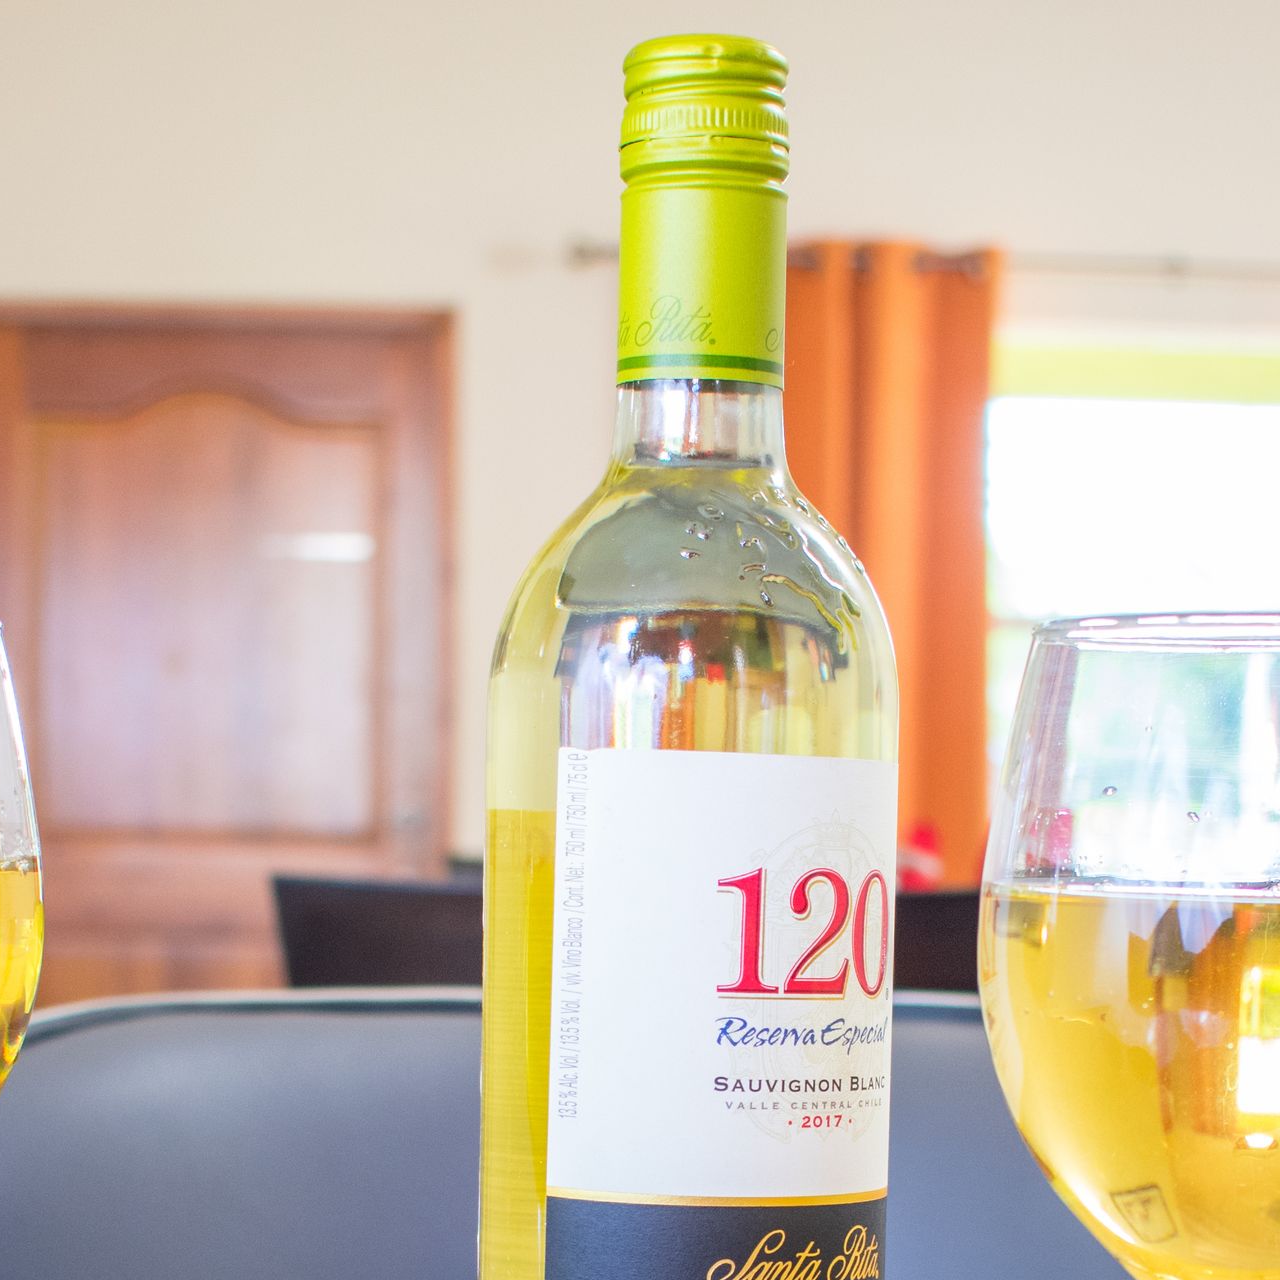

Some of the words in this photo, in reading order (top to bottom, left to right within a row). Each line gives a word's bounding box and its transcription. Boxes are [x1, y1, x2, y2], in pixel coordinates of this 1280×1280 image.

[567, 773, 587, 784] 75
[566, 791, 586, 802] ml
[566, 804, 586, 820] 750
[565, 827, 585, 839] ml
[565, 840, 585, 856] 750
[562, 917, 583, 947] Blanco
[716, 867, 889, 1000] 120
[561, 949, 582, 968] Vino
[714, 1016, 817, 1047] Reserva
[820, 1016, 888, 1055] Especial
[713, 1076, 842, 1093] SAUVIGNON
[849, 1075, 886, 1091] BLANC
[725, 1101, 782, 1110] VALLE
[790, 1100, 852, 1110] CENTRAL
[858, 1097, 882, 1108] CHILE
[801, 1114, 843, 1129] 2017
